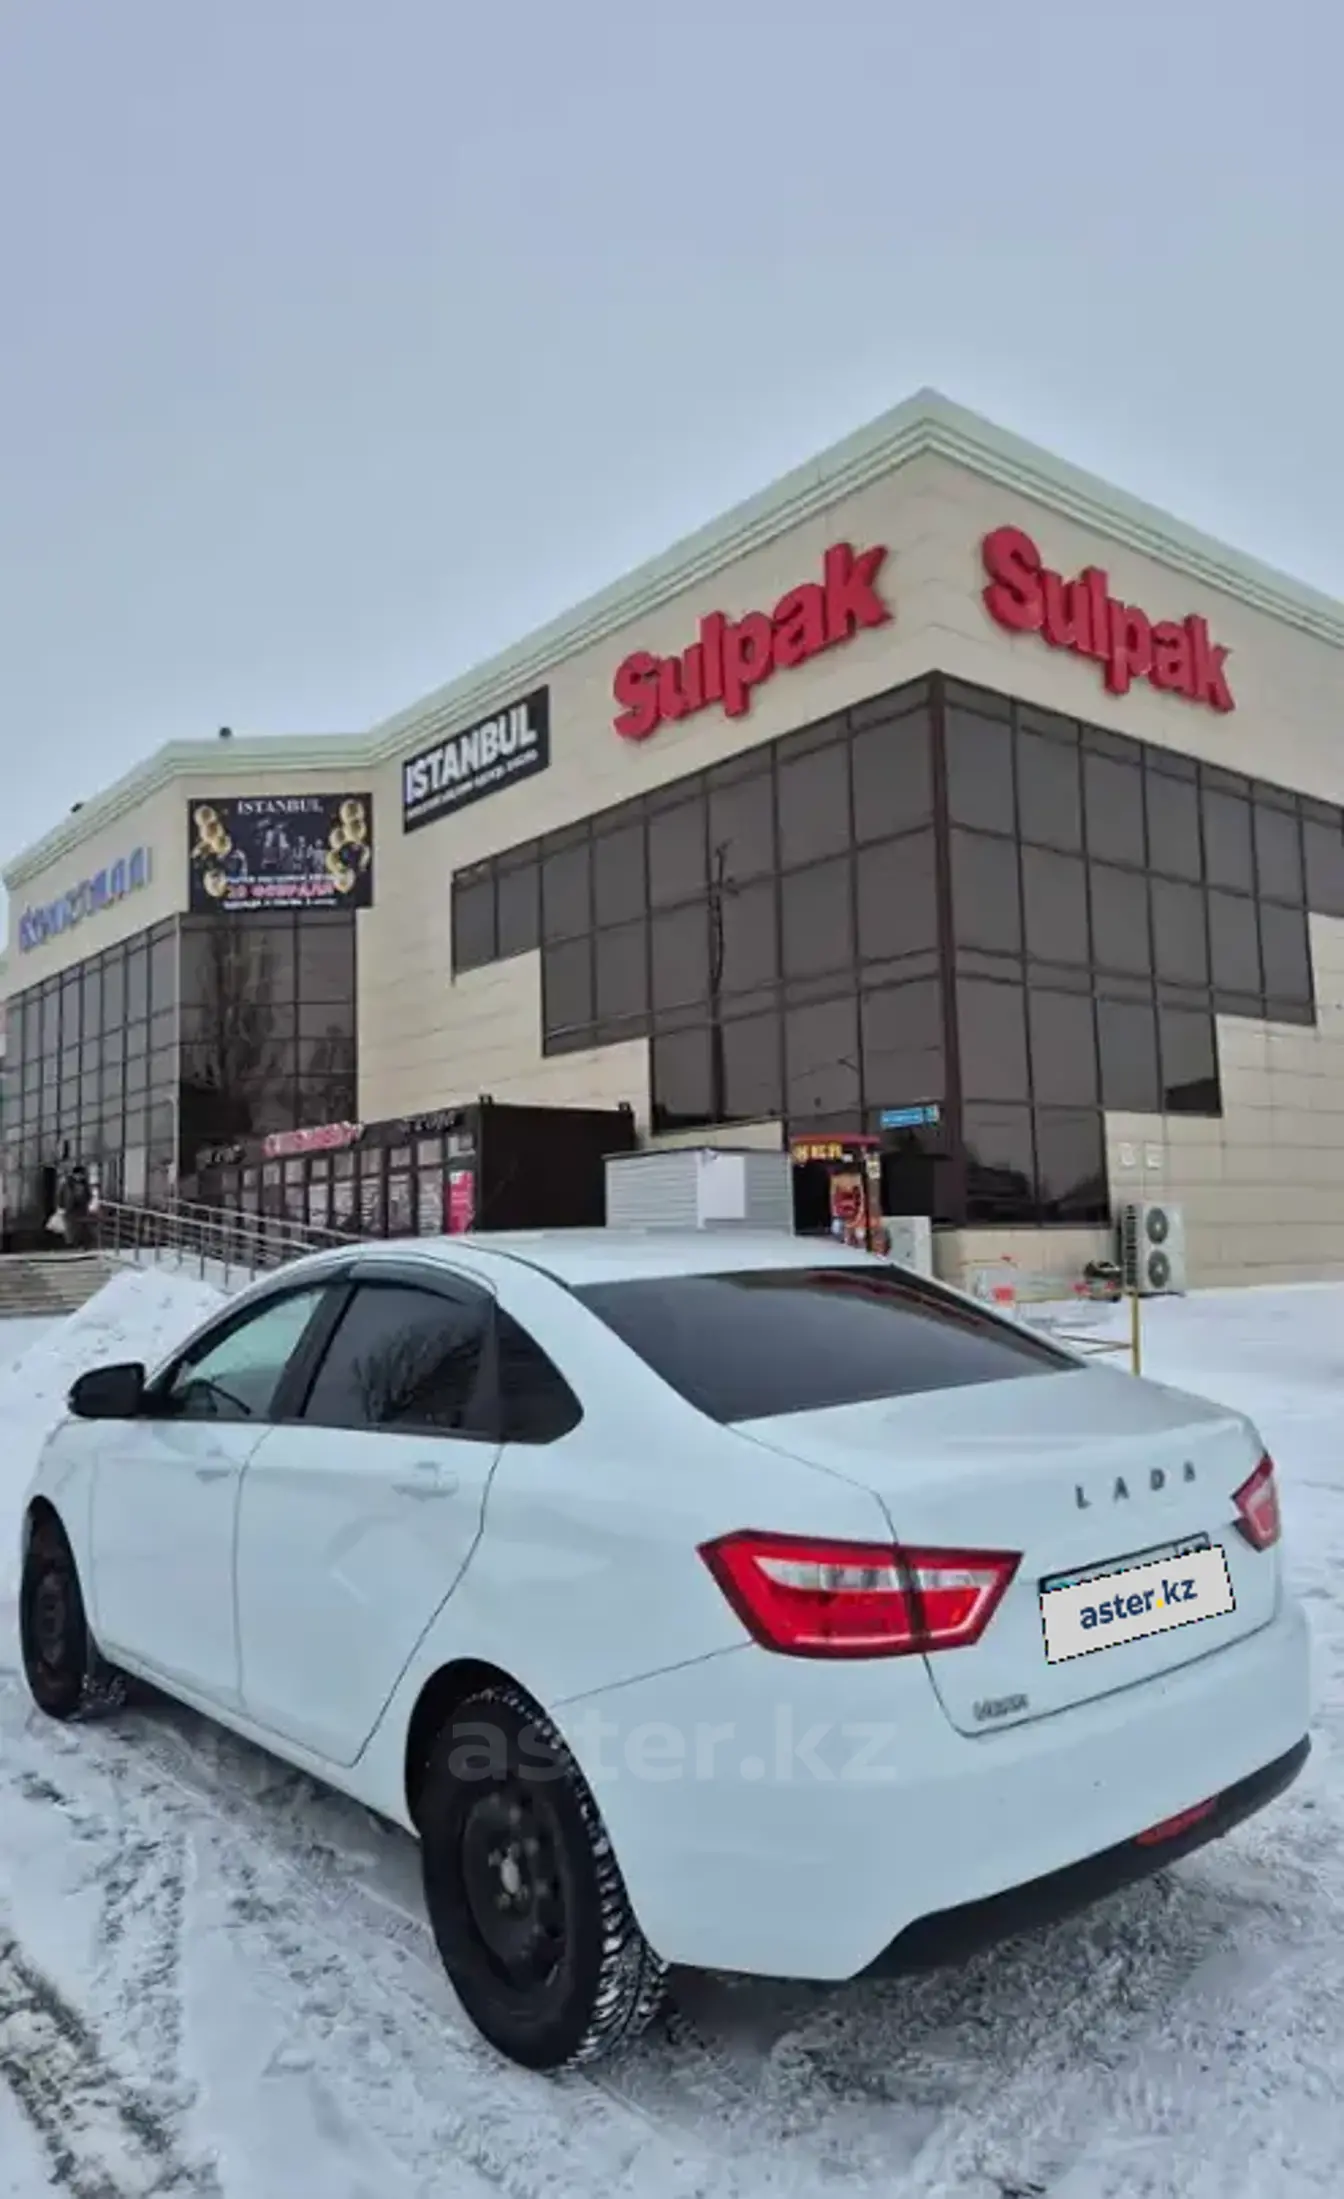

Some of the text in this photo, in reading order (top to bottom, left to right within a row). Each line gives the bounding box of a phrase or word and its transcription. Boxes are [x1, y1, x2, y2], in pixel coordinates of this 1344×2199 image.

[613, 542, 893, 740] Sulpak
[981, 525, 1236, 713] Sulpak
[405, 703, 539, 804] ISTANBUL
[1075, 1459, 1196, 1510] LADA
